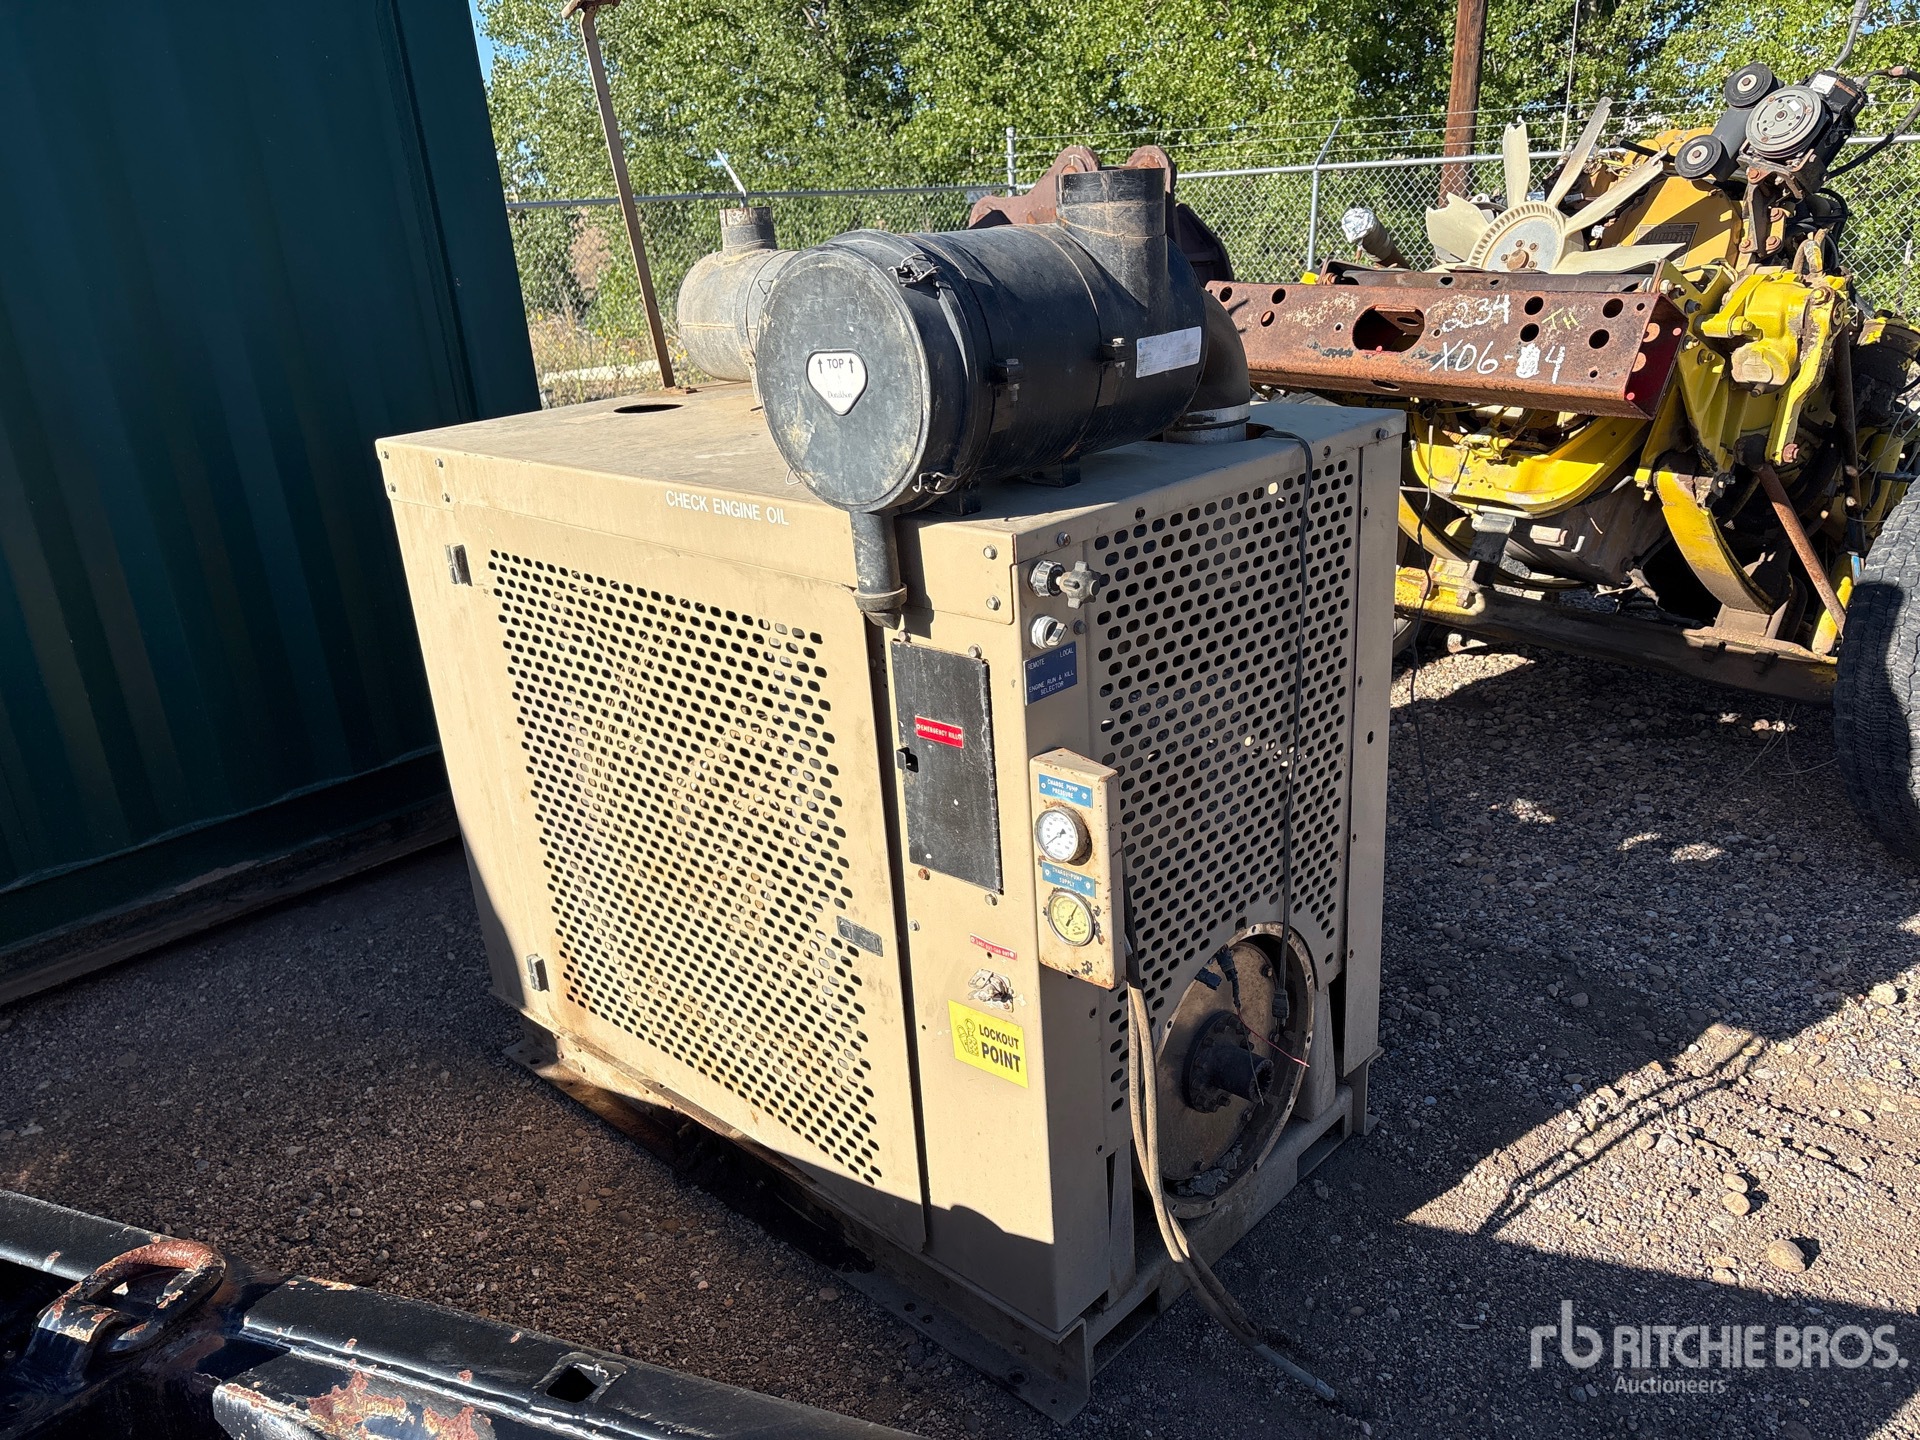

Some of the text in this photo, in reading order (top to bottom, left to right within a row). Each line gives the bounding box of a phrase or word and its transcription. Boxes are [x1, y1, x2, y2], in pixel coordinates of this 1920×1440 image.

[1442, 294, 1510, 332] 234
[826, 358, 845, 369] TOP
[665, 490, 790, 526] CHECK ENGINE OIL
[1027, 647, 1074, 670] REMOTE LOCAL
[1028, 680, 1045, 693] ENGINE
[1046, 677, 1057, 686] RUN
[1064, 669, 1075, 678] KILL
[1040, 680, 1065, 696] SELECTOR
[920, 724, 947, 737] EMERGENCY
[1066, 783, 1079, 792] PUMP
[978, 1023, 1020, 1050] LOCKOUT
[981, 1040, 1021, 1073] POINT
